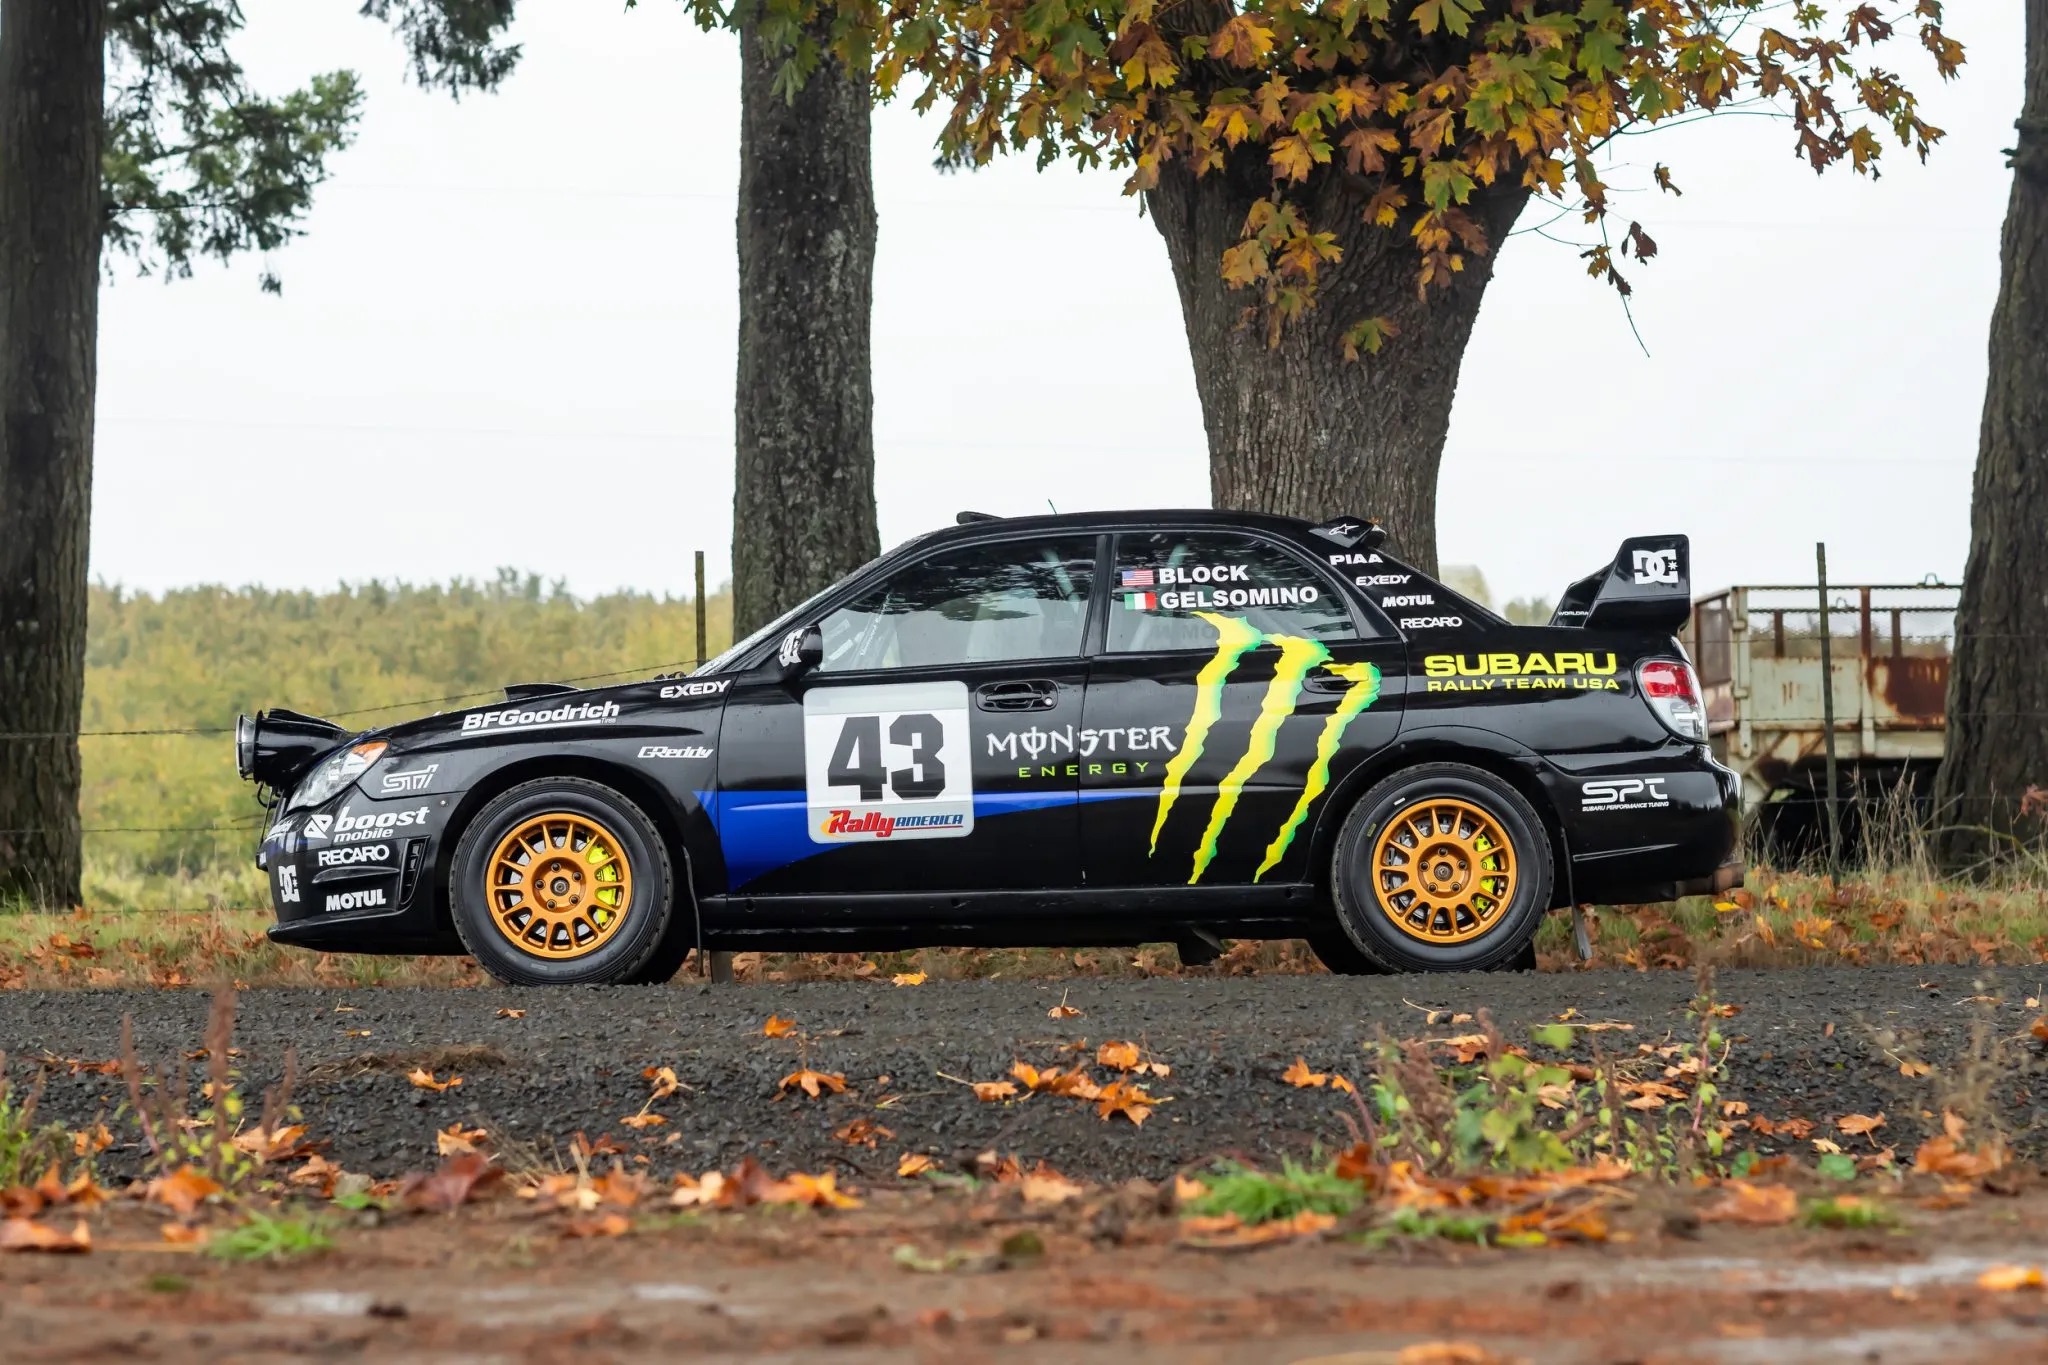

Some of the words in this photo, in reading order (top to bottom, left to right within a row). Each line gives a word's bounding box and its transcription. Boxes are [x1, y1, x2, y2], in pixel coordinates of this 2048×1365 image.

[1329, 553, 1383, 566] PIAA
[1632, 549, 1679, 585] DC
[1159, 564, 1249, 584] BLOCK
[1355, 574, 1412, 587] EXEDY
[1160, 586, 1318, 609] GELSOMINO
[1382, 595, 1434, 608] MOTUL
[1400, 616, 1462, 629] RECARO
[1424, 652, 1617, 678] SUBARU
[659, 680, 732, 699] EXEDY
[1427, 679, 1496, 692] RALLY
[1502, 677, 1566, 690] TEAM
[1573, 677, 1620, 690] USA
[462, 701, 620, 730] BFGoodrich
[637, 746, 714, 759] GReddy
[827, 713, 946, 802] 43
[1018, 762, 1149, 778] ENERGY
[1582, 778, 1668, 804] SPT
[334, 807, 430, 833] boost
[828, 810, 896, 837] Rally
[895, 814, 963, 827] AMERICA
[334, 828, 393, 843] mobile
[318, 844, 390, 867] RECARO
[326, 889, 386, 911] MOTUL
